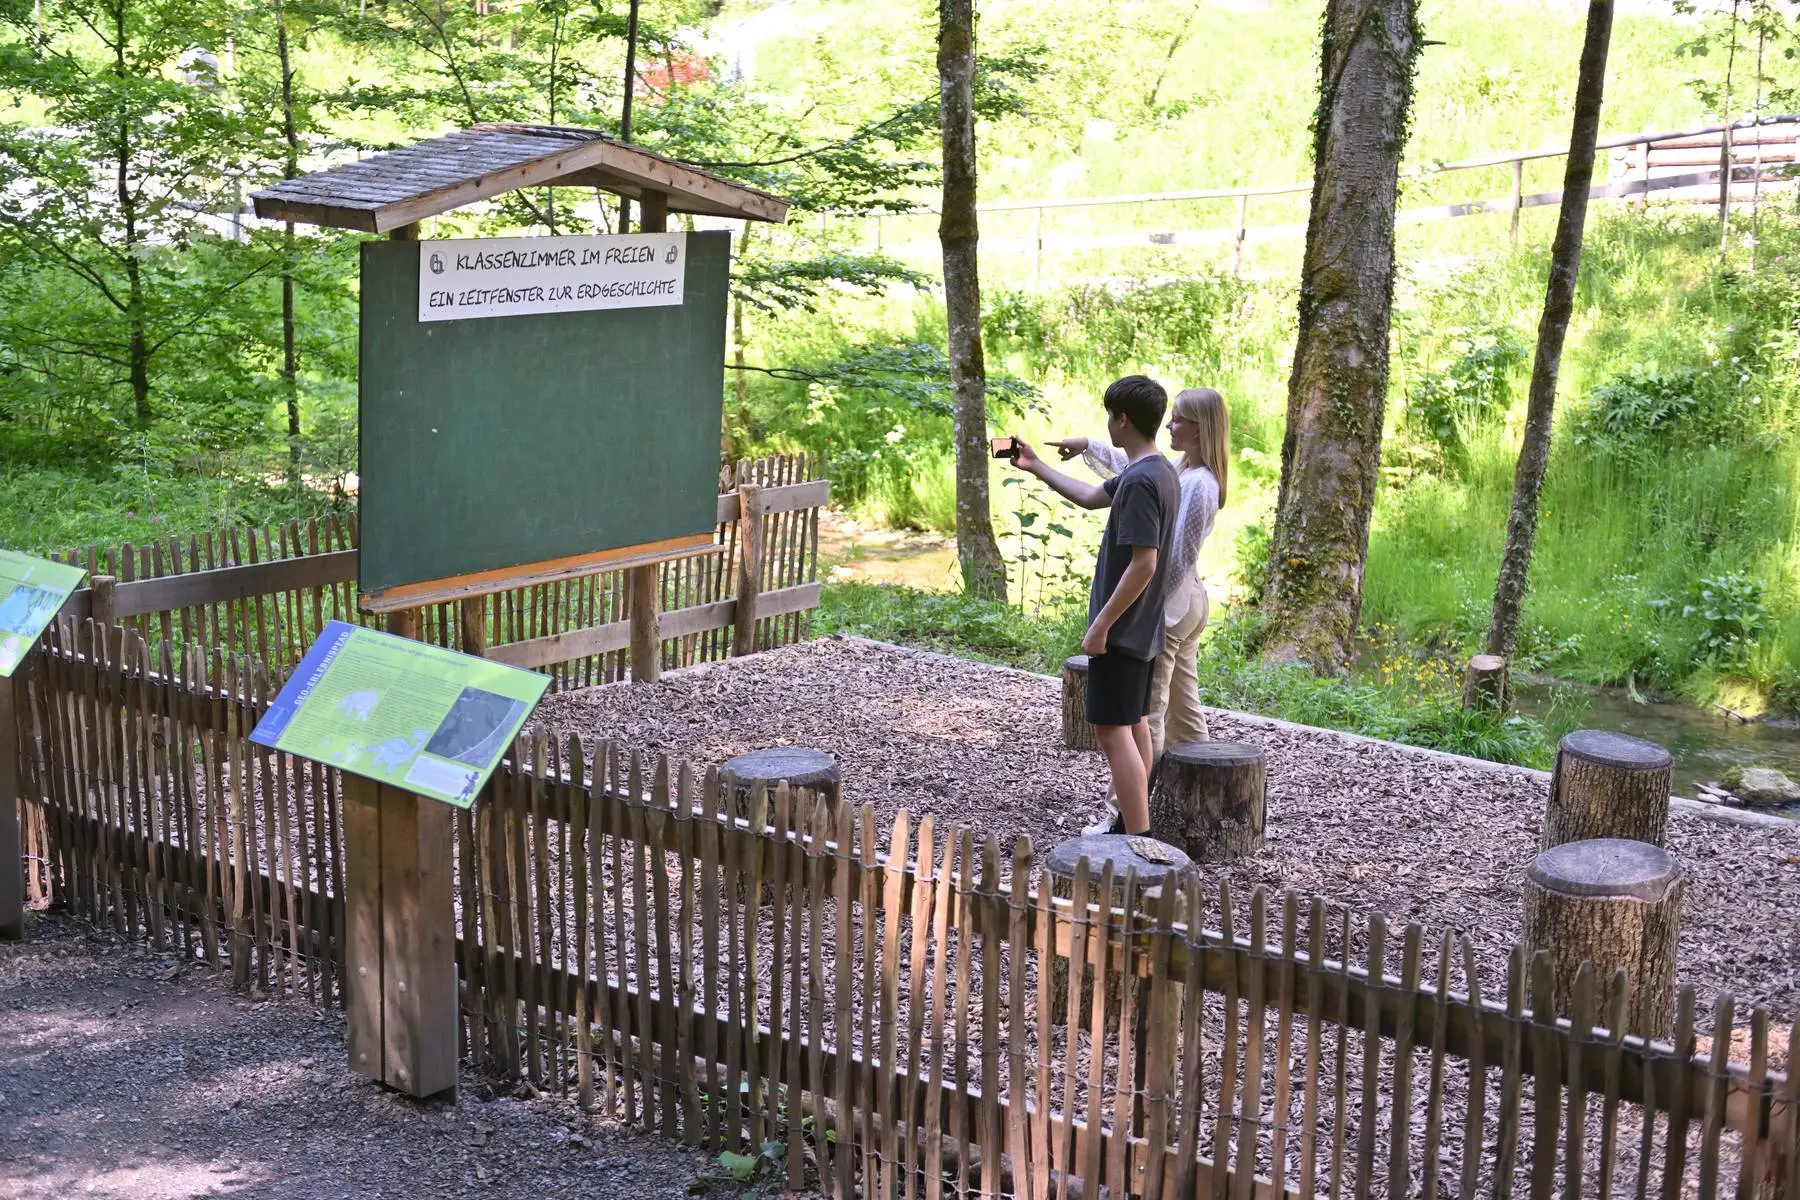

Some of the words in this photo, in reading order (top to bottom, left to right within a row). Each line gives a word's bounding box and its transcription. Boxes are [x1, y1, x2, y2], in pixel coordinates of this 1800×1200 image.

[457, 247, 576, 271] KLASSENZIMMER
[580, 248, 600, 265] IM
[605, 246, 655, 265] FREIEN
[429, 291, 454, 308] EIN
[458, 286, 544, 306] ZEITFENSTER
[548, 285, 572, 301] ZUR
[577, 279, 677, 299] ERDGESCHICHTE
